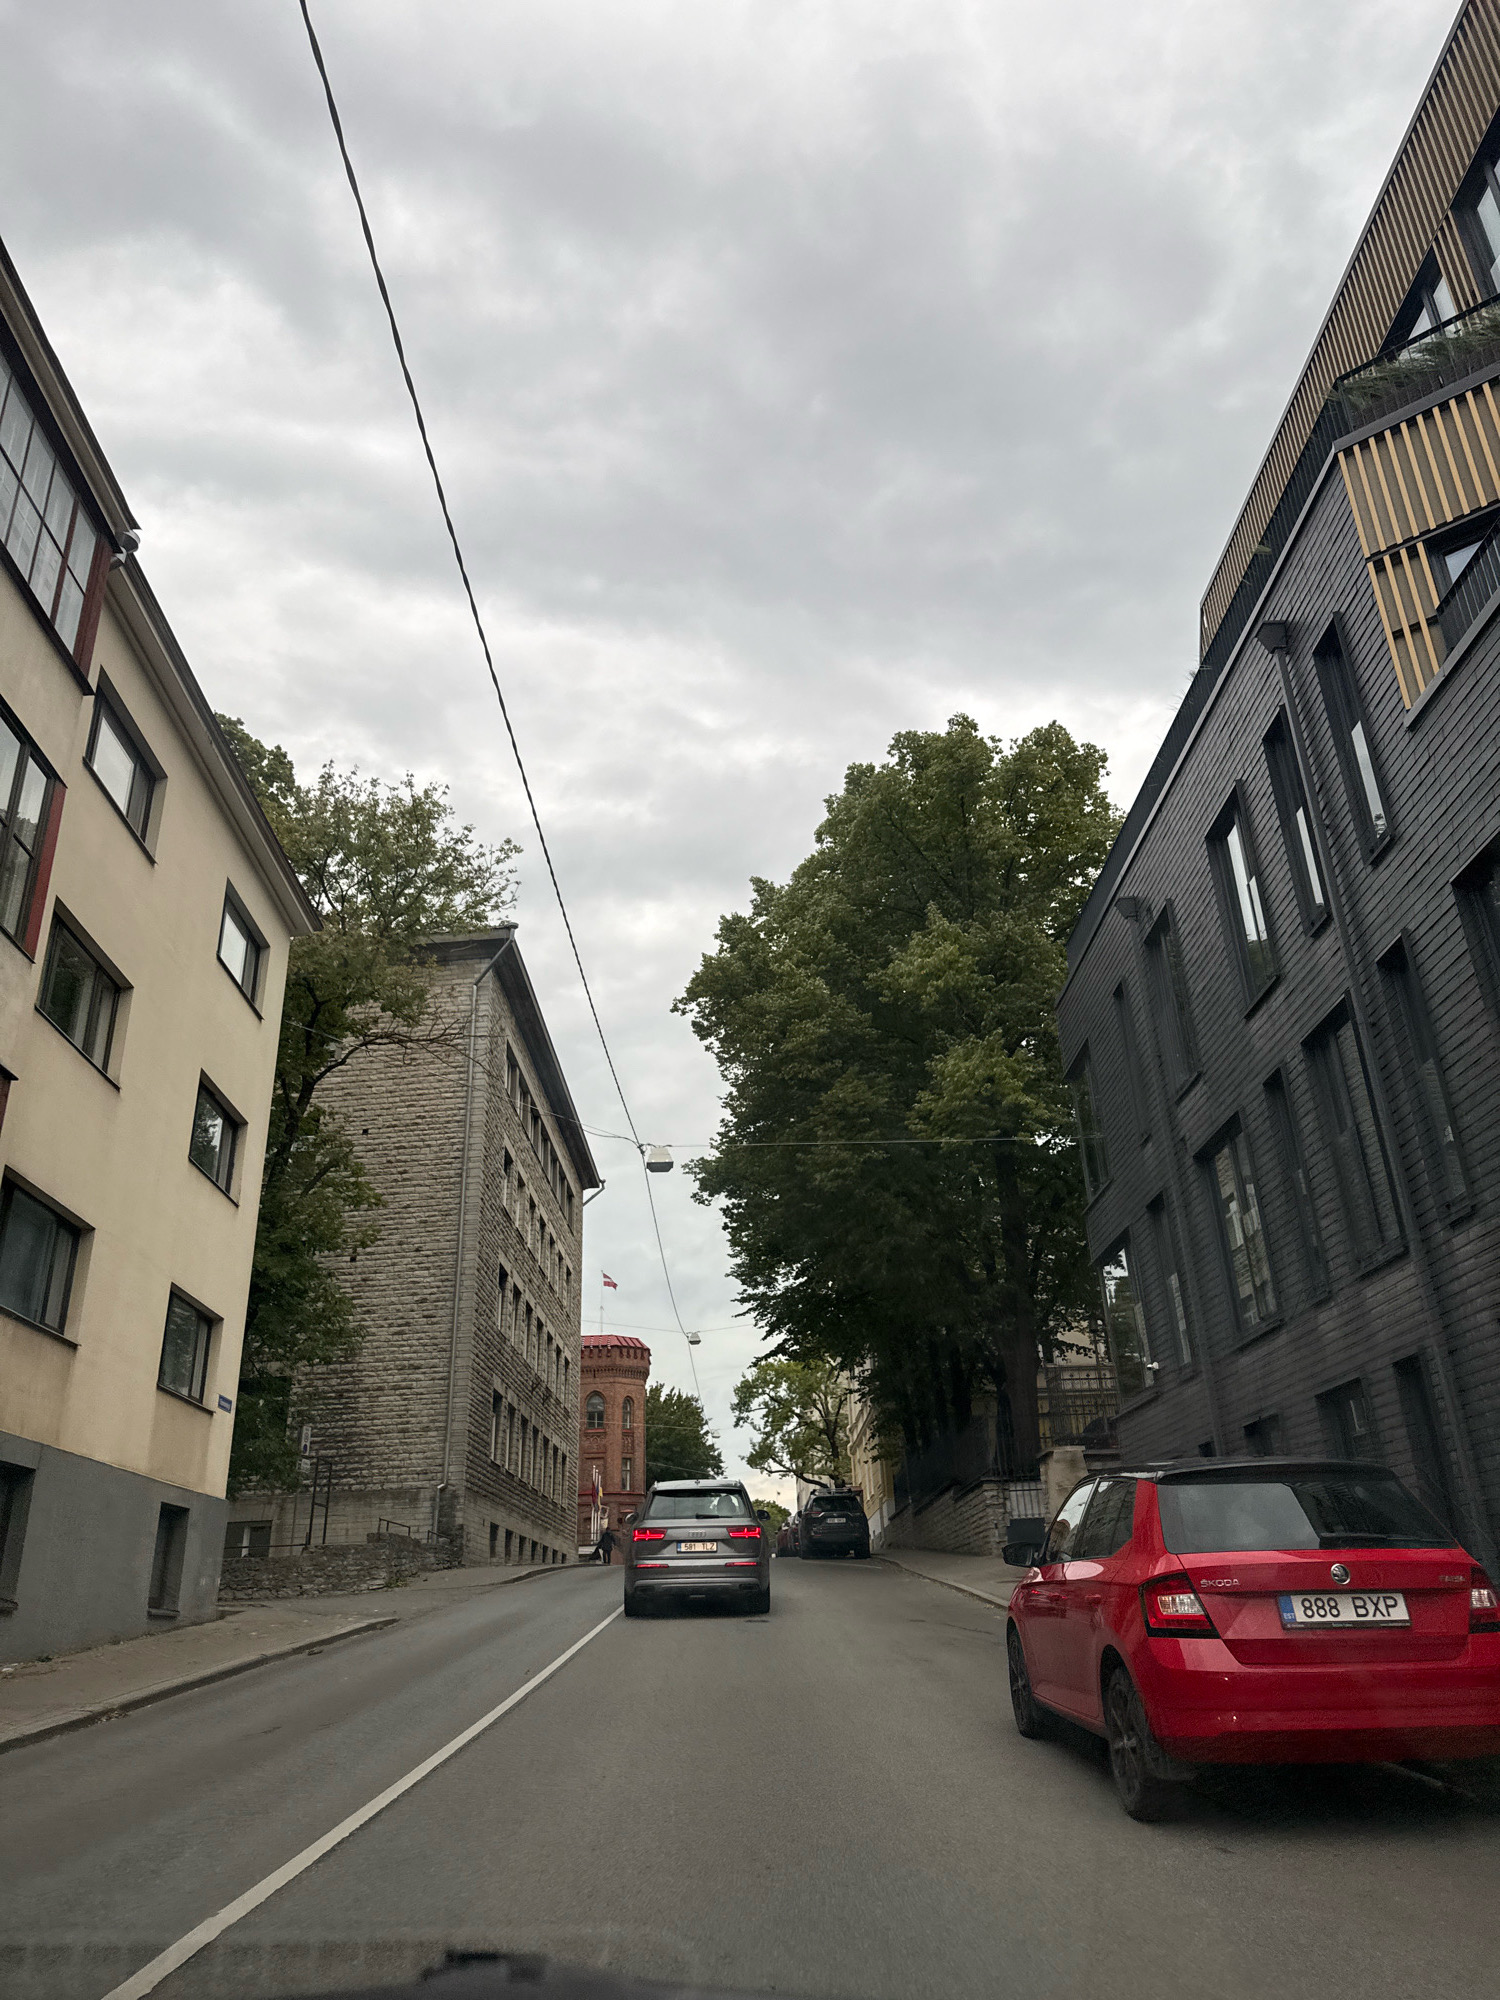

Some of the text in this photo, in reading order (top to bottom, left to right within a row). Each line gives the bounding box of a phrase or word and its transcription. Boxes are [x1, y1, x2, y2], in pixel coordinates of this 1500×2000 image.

[684, 1543, 696, 1551] 581
[1301, 1596, 1398, 1618] 888 BXP
